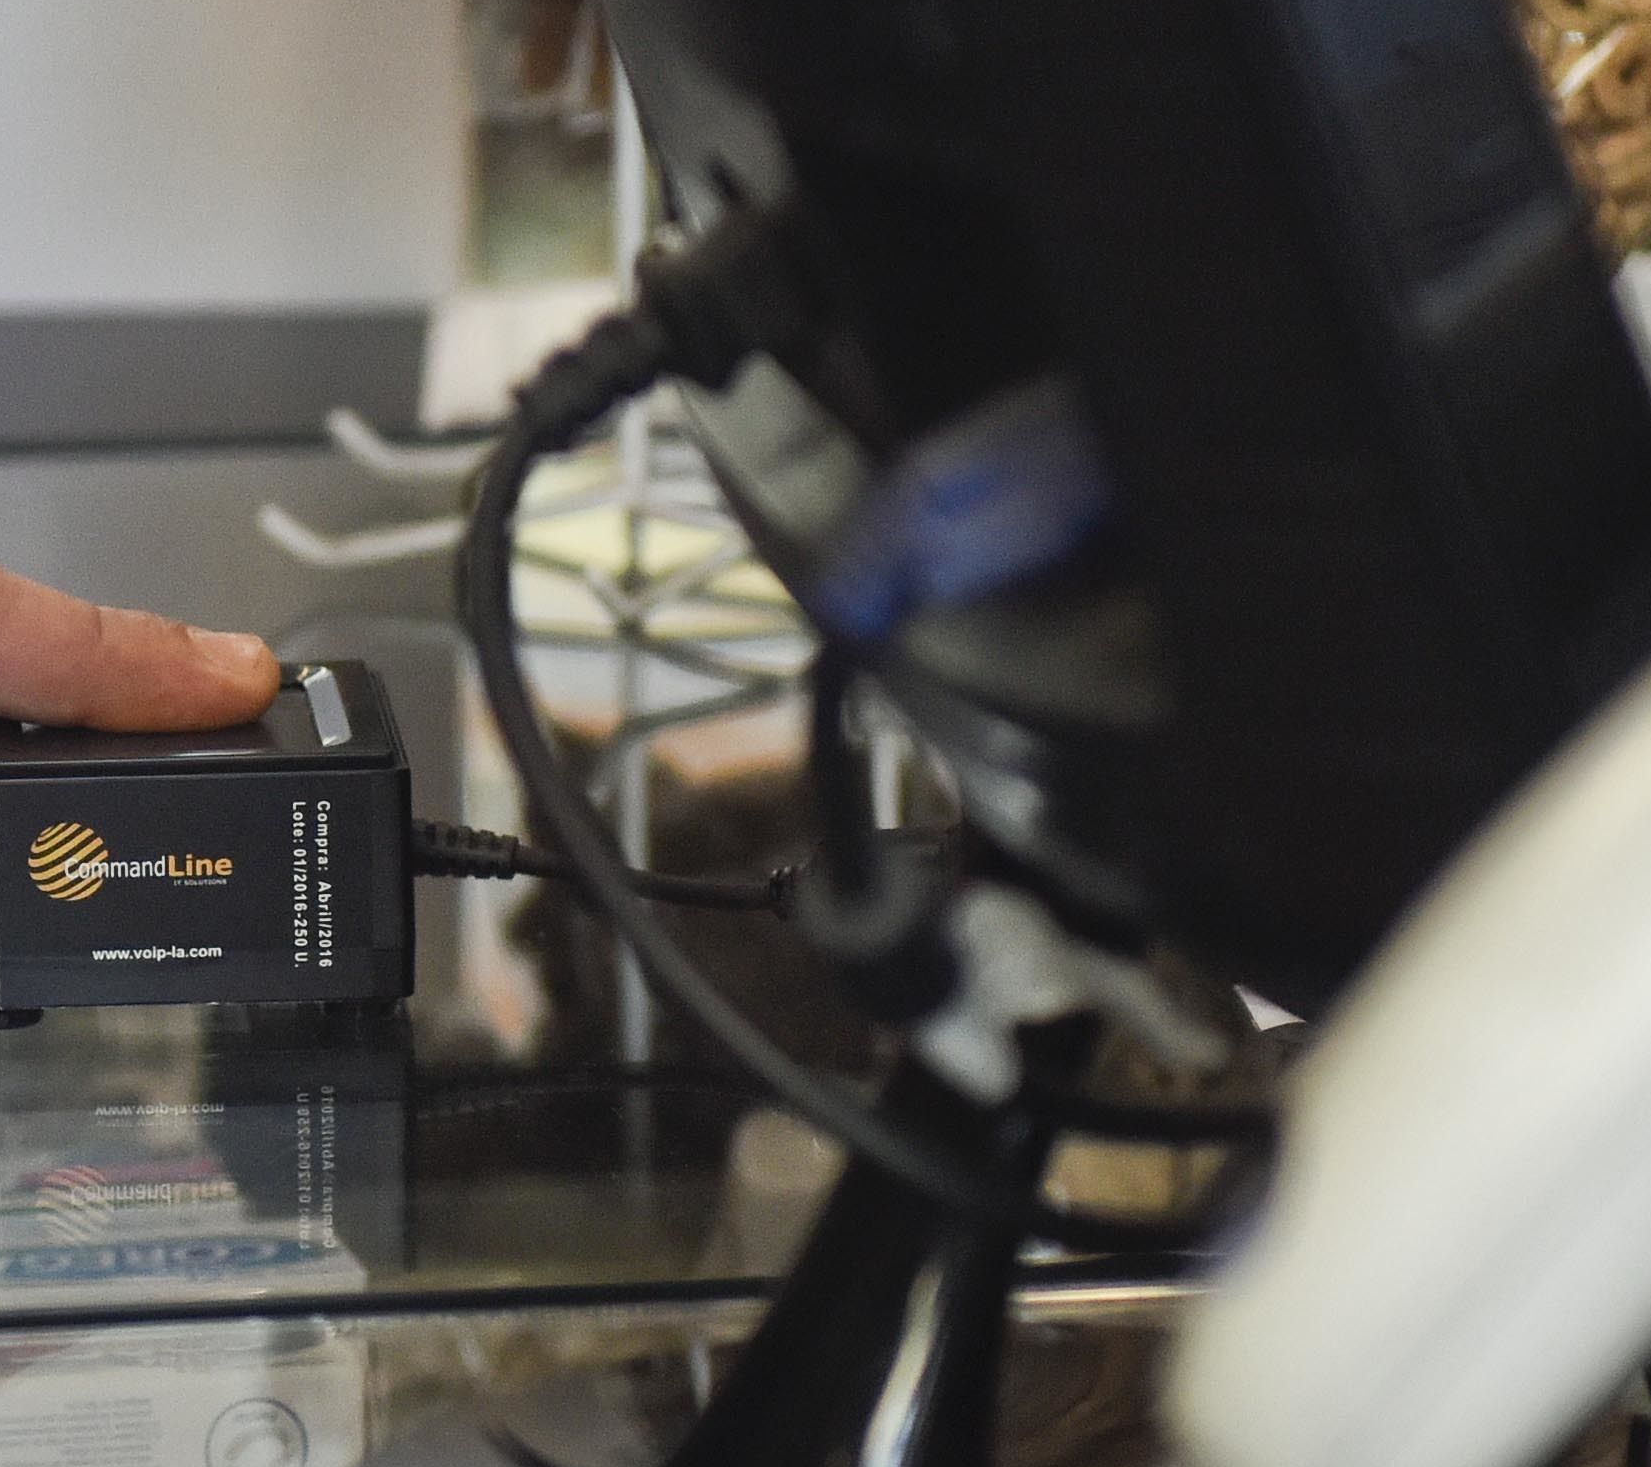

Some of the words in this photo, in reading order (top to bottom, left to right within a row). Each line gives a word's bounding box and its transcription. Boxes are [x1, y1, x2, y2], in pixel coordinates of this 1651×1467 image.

[292, 801, 307, 843] Lote:
[314, 800, 331, 871] Compra:
[64, 853, 233, 879] CommandLine
[293, 848, 309, 947] 01/2016-250
[317, 881, 333, 968] Abril/2016
[92, 945, 223, 962] www.voip-la.com
[294, 952, 309, 968] U.
